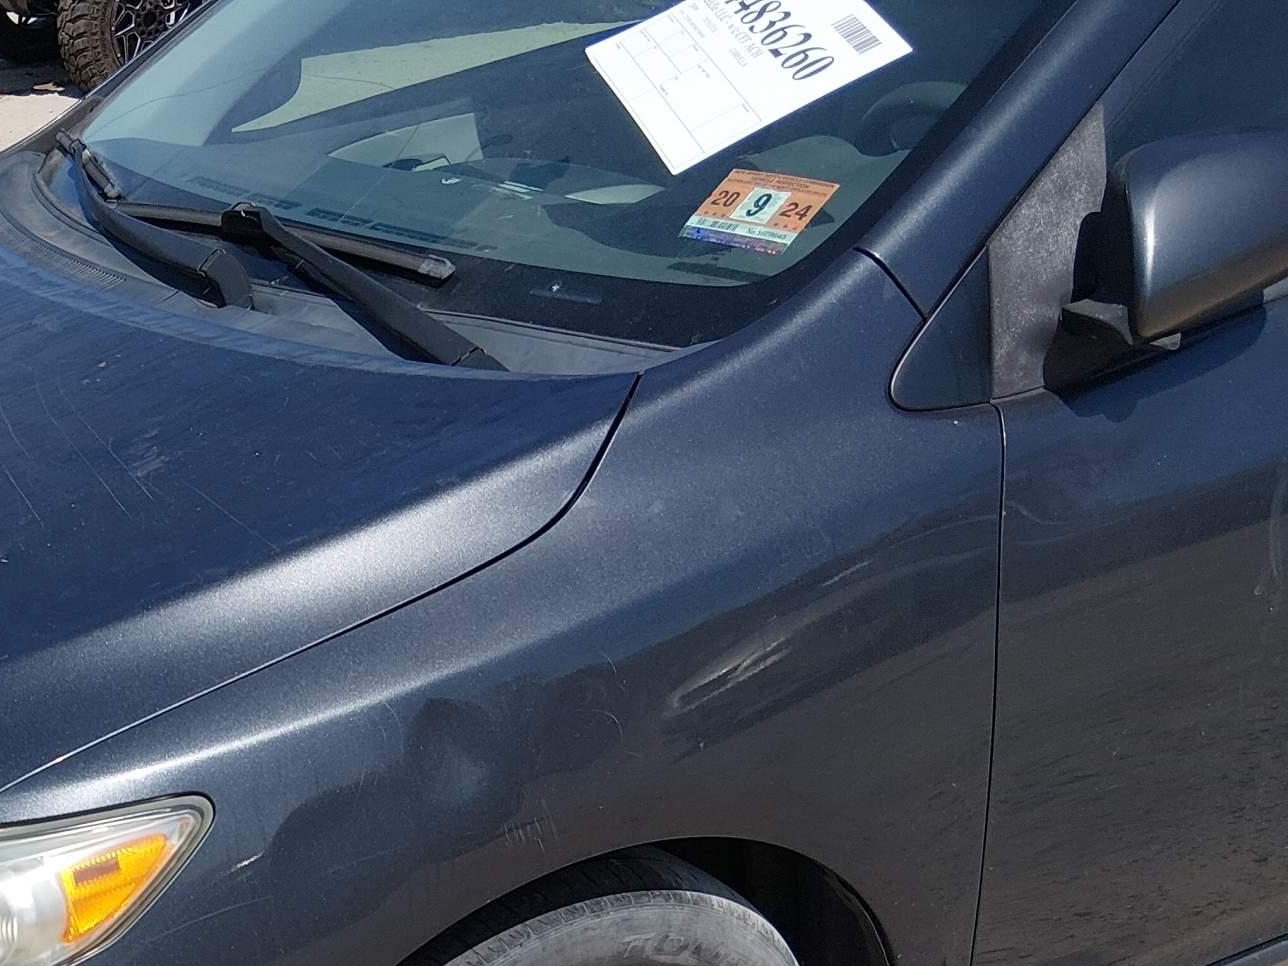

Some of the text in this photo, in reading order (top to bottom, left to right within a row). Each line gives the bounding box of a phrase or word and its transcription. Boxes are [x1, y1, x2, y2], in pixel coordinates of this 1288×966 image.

[711, 190, 813, 221] 20 9 24
